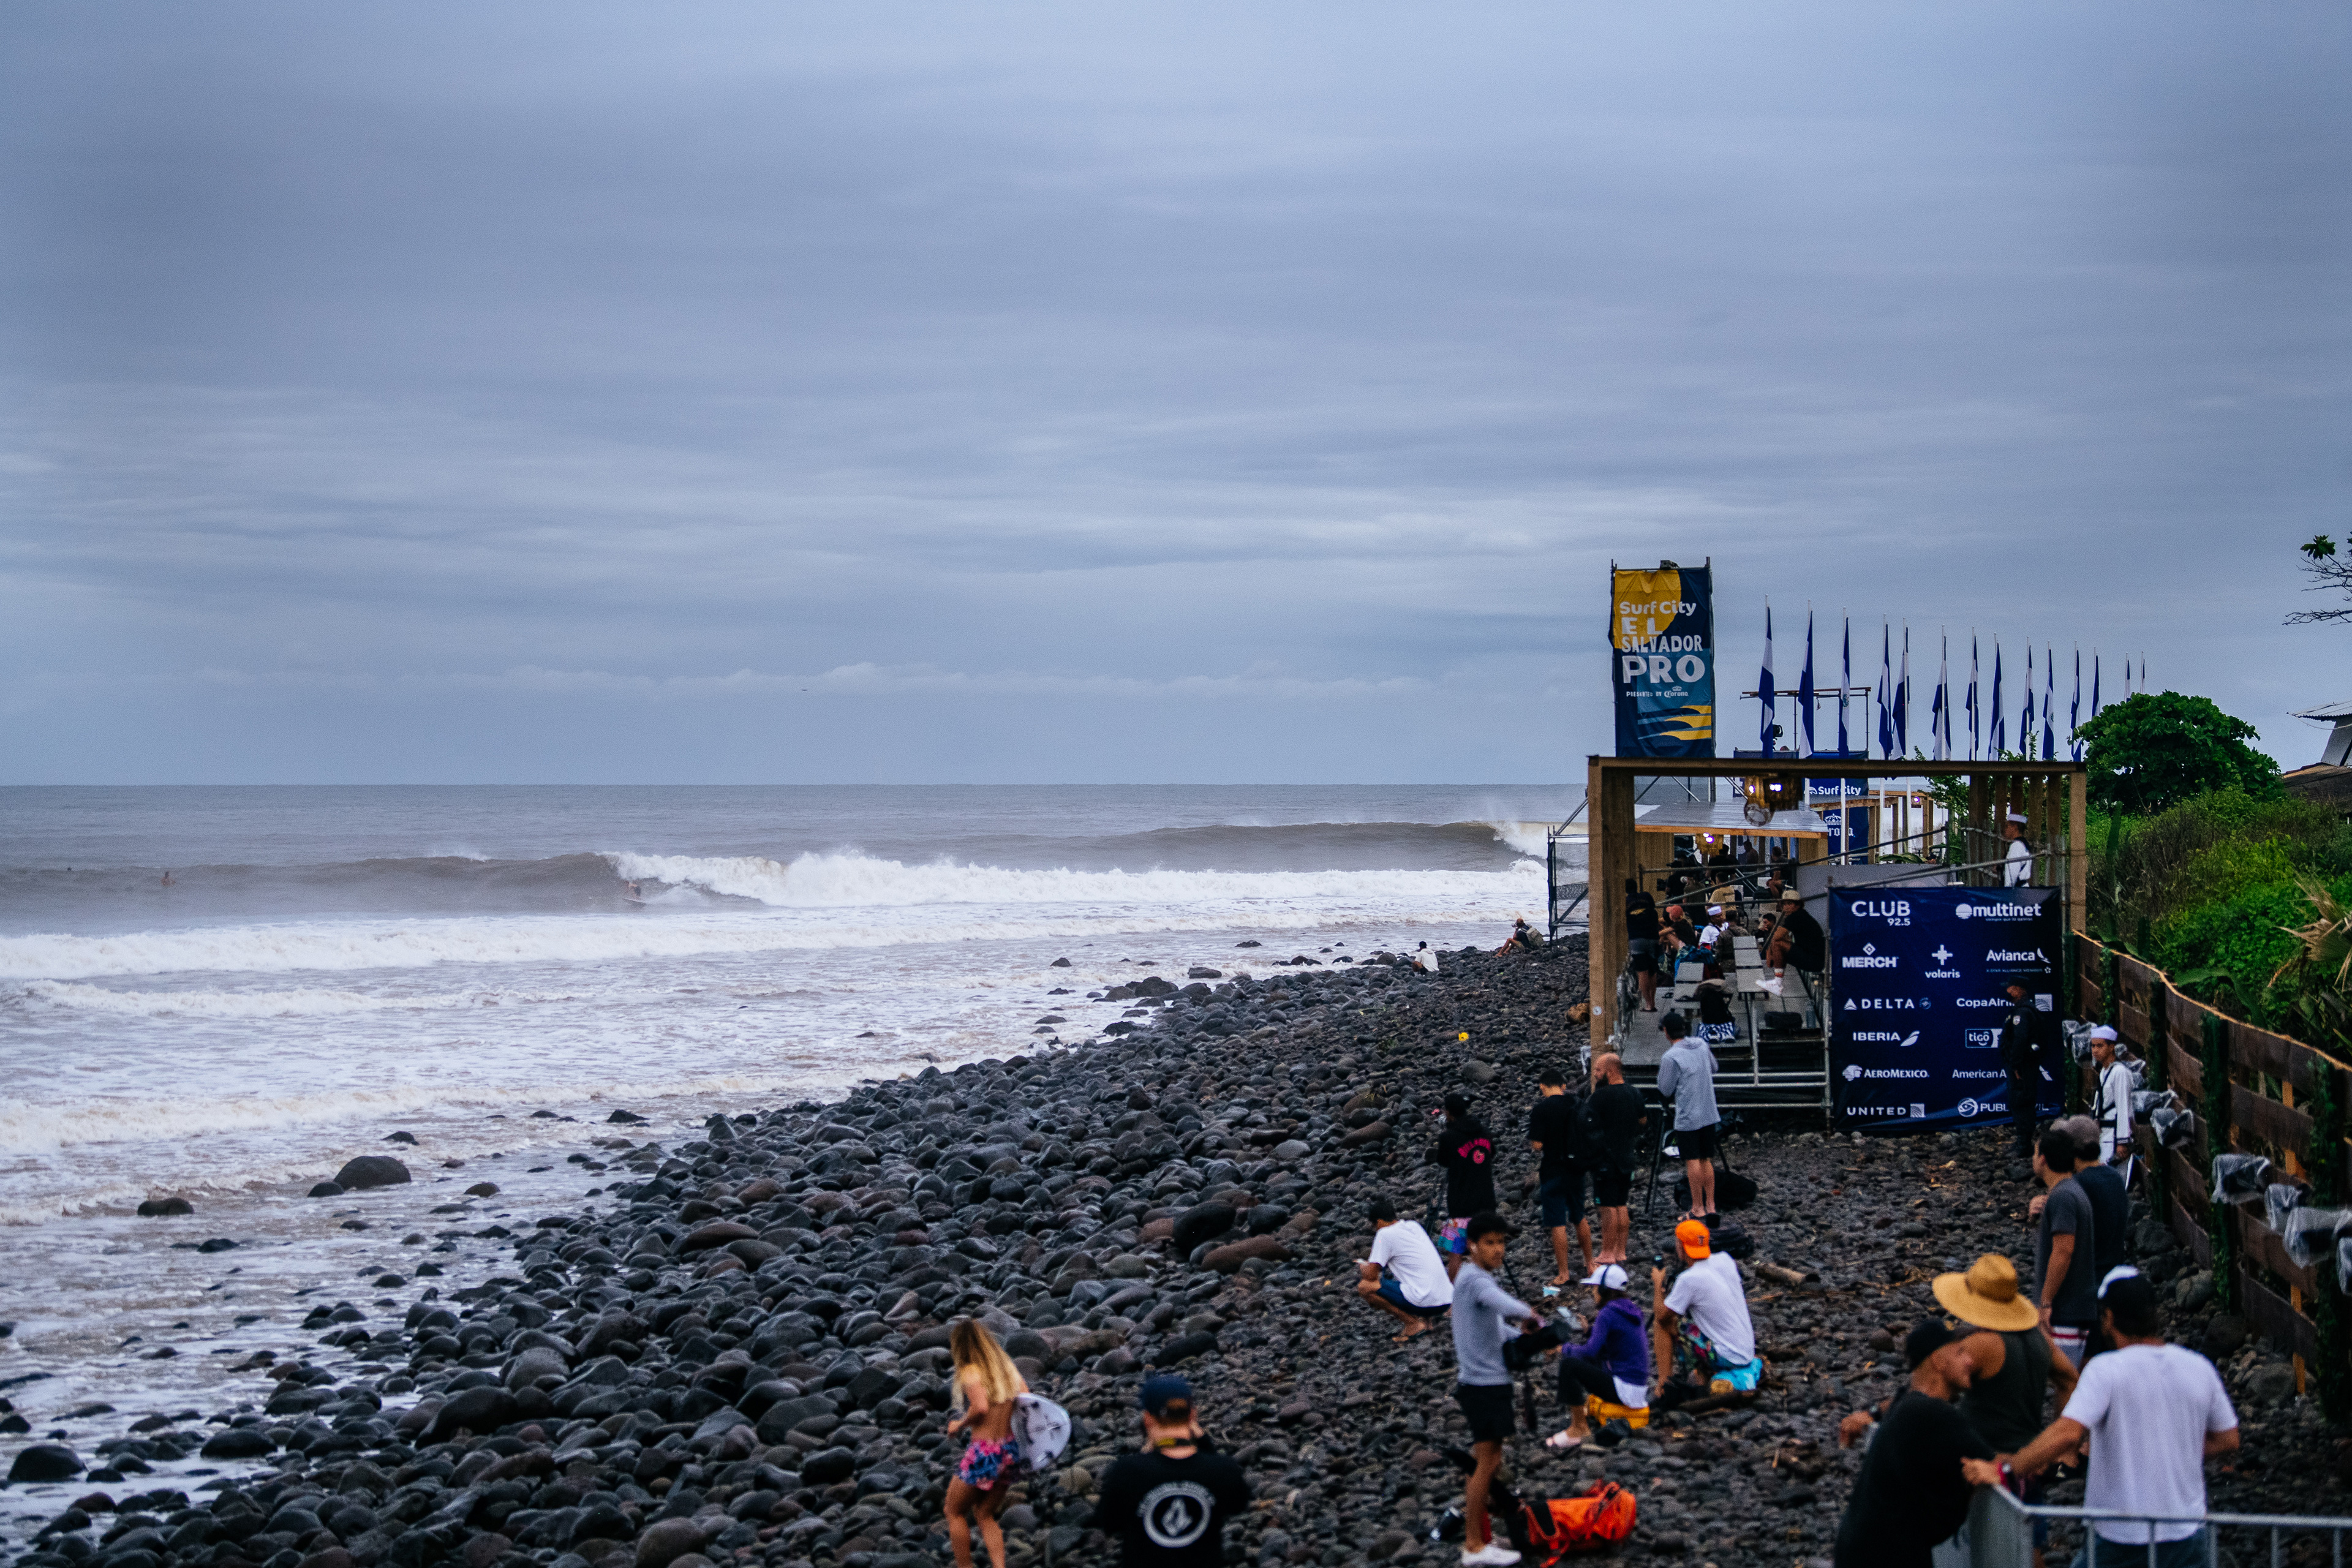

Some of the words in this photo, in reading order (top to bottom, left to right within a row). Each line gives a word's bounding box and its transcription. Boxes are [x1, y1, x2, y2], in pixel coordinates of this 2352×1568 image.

[1619, 600, 1657, 614] Surf
[1659, 600, 1697, 616] City
[1621, 617, 1663, 635] EL
[1621, 635, 1703, 653] SALVADOR
[1622, 655, 1705, 684] PRO
[1818, 786, 1839, 795] Surf
[1851, 900, 1910, 917] CLUB
[1973, 902, 2041, 917] multinet
[1887, 918, 1910, 926] 92.5
[1986, 949, 2035, 962] Avianca
[1842, 956, 1897, 968] MERCH
[1924, 968, 1961, 978] volaris
[1861, 998, 1915, 1009] DELTA
[1853, 1031, 1901, 1041] IBERIA
[1952, 1069, 1998, 1078] American
[1847, 1106, 1906, 1115] UNITED
